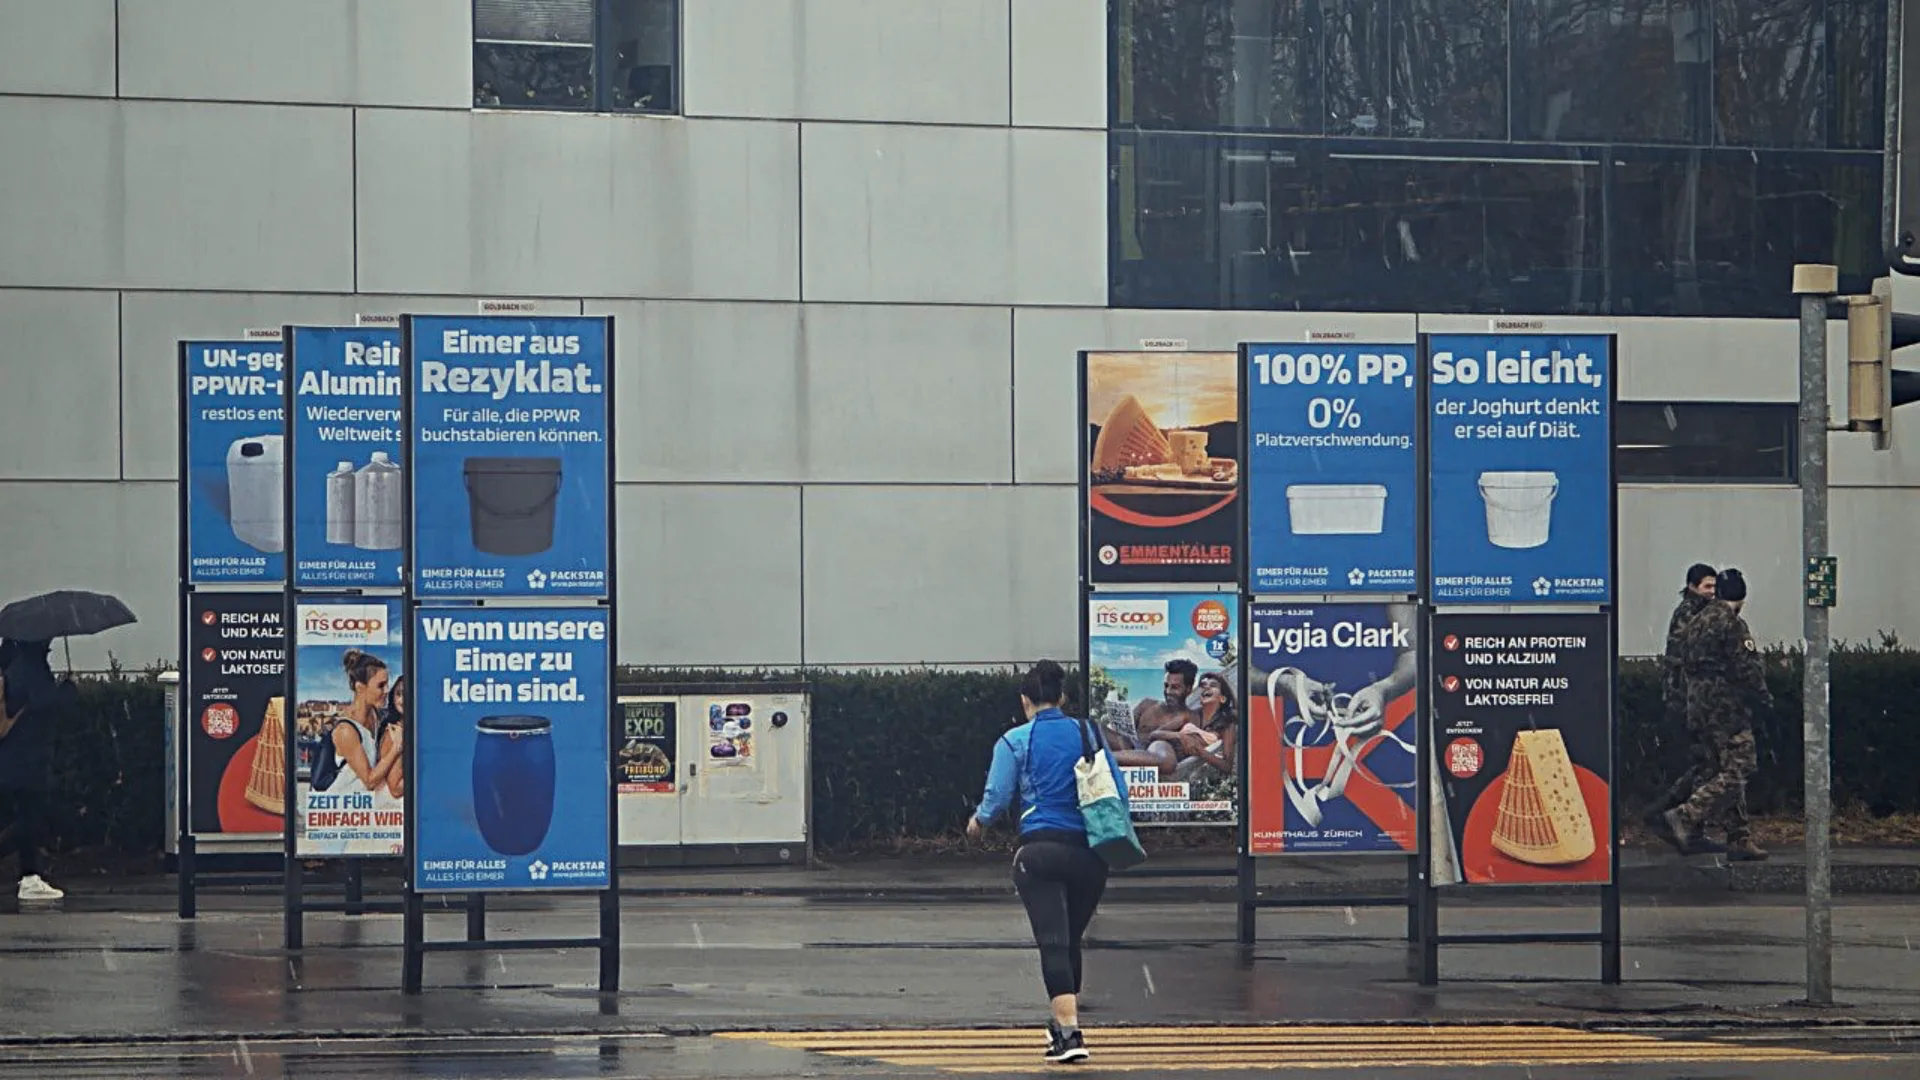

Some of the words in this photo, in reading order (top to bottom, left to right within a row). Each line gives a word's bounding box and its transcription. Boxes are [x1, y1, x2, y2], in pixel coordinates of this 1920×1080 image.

[443, 330, 525, 354] Eimer
[529, 335, 580, 354] aus
[203, 350, 284, 371] UN-gep
[1254, 353, 1351, 384] 100%
[1358, 354, 1413, 388] PP,
[1432, 352, 1479, 384] So
[1487, 350, 1602, 387] leicht,
[422, 360, 602, 400] Rezyklat.
[202, 407, 255, 420] restlos
[1308, 398, 1361, 428] 0%
[1435, 399, 1466, 415] der
[1468, 399, 1542, 418] Joghurt
[1545, 399, 1600, 415] denkt
[443, 408, 469, 423] Für
[472, 408, 503, 424] alle,
[505, 408, 529, 423] die
[532, 409, 580, 423] PPWR
[319, 427, 393, 441] Weltweit
[422, 427, 536, 442] buchstabieren
[539, 427, 602, 442] können.
[1454, 425, 1474, 438] er
[1477, 421, 1502, 438] sei
[1506, 421, 1536, 438] auf
[1539, 421, 1580, 438] Diät.
[1256, 432, 1413, 449] Platzverschwendung.
[1120, 545, 1231, 558] EMMENTALER
[422, 569, 452, 578] EIMER
[453, 567, 474, 578] FÜR
[475, 568, 505, 578] ALLES
[551, 571, 603, 580] PACKSTAR
[1257, 568, 1283, 576] EIMER
[1284, 566, 1302, 575] FÜR
[1303, 567, 1329, 575] ALLES
[424, 581, 453, 589] ALLES
[454, 579, 473, 589] FÜR
[475, 580, 504, 588] EIMER
[1259, 578, 1284, 586] ALLES
[1285, 577, 1300, 586] FÜR
[1302, 578, 1327, 586] EIMER
[1435, 577, 1463, 585] EIMER
[1465, 575, 1484, 585] FÜR
[1484, 576, 1512, 585] ALLES
[1555, 578, 1604, 587] PACKSTAR
[1438, 588, 1464, 596] ALLES
[1466, 587, 1482, 596] FÜR
[1484, 588, 1511, 596] EIMER
[221, 613, 259, 623] REICH
[262, 613, 280, 623] AN
[1096, 612, 1118, 623] ITS
[1120, 612, 1164, 626] coop
[221, 628, 248, 638] UND
[251, 627, 284, 638] KALZ
[305, 618, 329, 631] ITS
[332, 618, 382, 634] coop
[423, 617, 503, 641] Wenn
[508, 620, 605, 641] unsere
[1253, 622, 1327, 654] Lygia
[1332, 622, 1409, 648] Clark
[1465, 637, 1505, 649] REICH
[1508, 637, 1526, 649] AN
[1530, 637, 1586, 649] PROTEIN
[221, 650, 247, 660] VON
[250, 650, 286, 660] NATU
[455, 648, 539, 672] Eimer
[540, 652, 573, 671] zu
[1465, 653, 1493, 664] UND
[1497, 653, 1556, 664] KALZIUM
[443, 678, 513, 702] klein
[517, 677, 585, 702] sind.
[1465, 678, 1493, 690] VON
[1496, 678, 1538, 689] NATUR
[1541, 678, 1568, 689] AUS
[1465, 694, 1553, 705] LAKTOSEFREI
[625, 718, 664, 736] EXPO
[1130, 765, 1156, 783] FÜR
[1157, 785, 1186, 798] WIR.
[308, 795, 339, 809] ZEIT
[343, 791, 373, 809] FÜR
[308, 812, 370, 827] EINFACH
[374, 812, 403, 826] WIR
[1253, 831, 1319, 839] KUNSTHAUS
[1323, 829, 1363, 838] ZÜRICH
[424, 861, 453, 870] EIMER
[455, 859, 475, 870] FÜR
[476, 860, 506, 870] ALLES
[552, 861, 605, 870] PACKSTAR
[426, 872, 454, 881] ALLES
[456, 871, 475, 881] FÜR
[476, 872, 504, 880] EIMER
